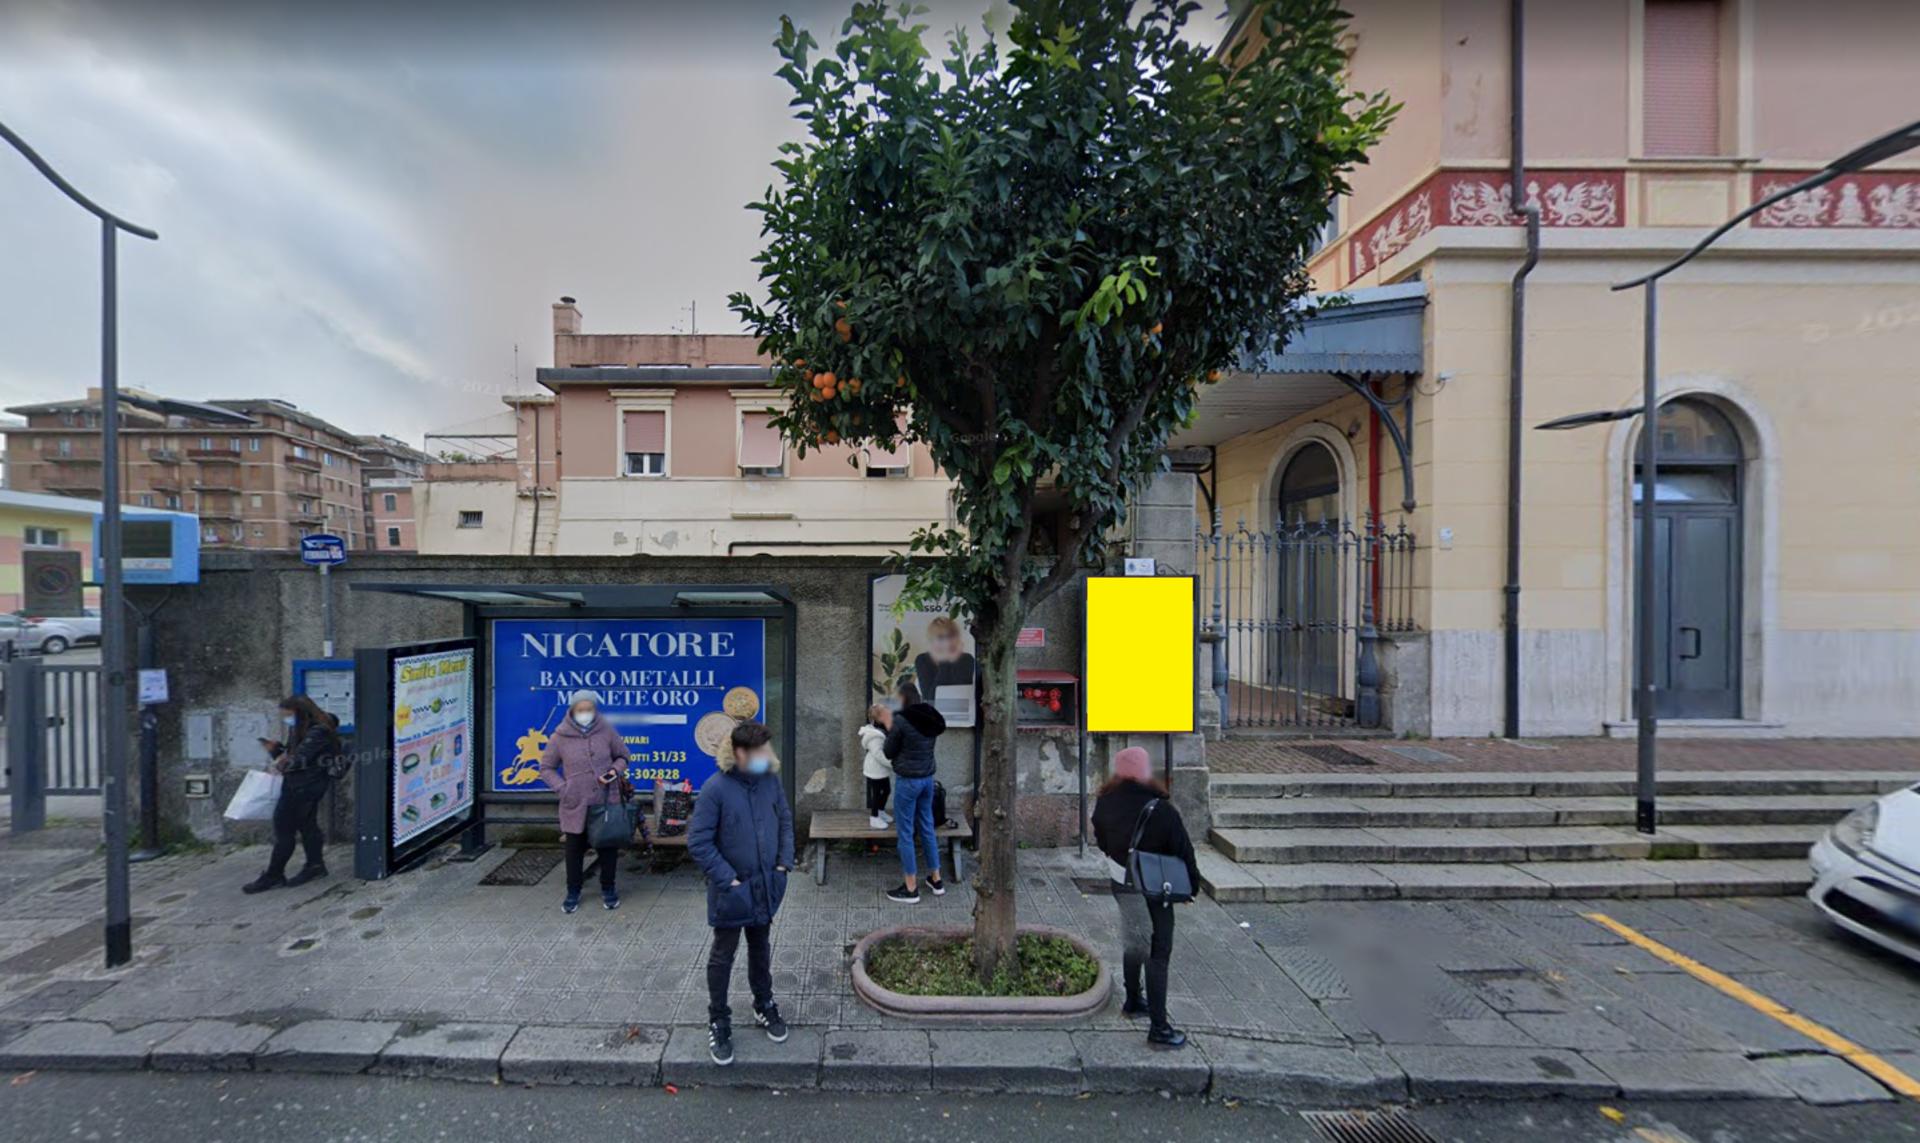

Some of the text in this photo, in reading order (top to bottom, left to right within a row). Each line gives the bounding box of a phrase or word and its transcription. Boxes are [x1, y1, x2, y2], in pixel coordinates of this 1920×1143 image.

[521, 632, 735, 658] NICATORE
[540, 670, 715, 687] BANCO METALLI
[557, 690, 700, 706] MNETE ORO
[621, 735, 650, 745] AVARI
[629, 751, 687, 763] OTTI 31/33
[623, 768, 680, 780] 5-302828
